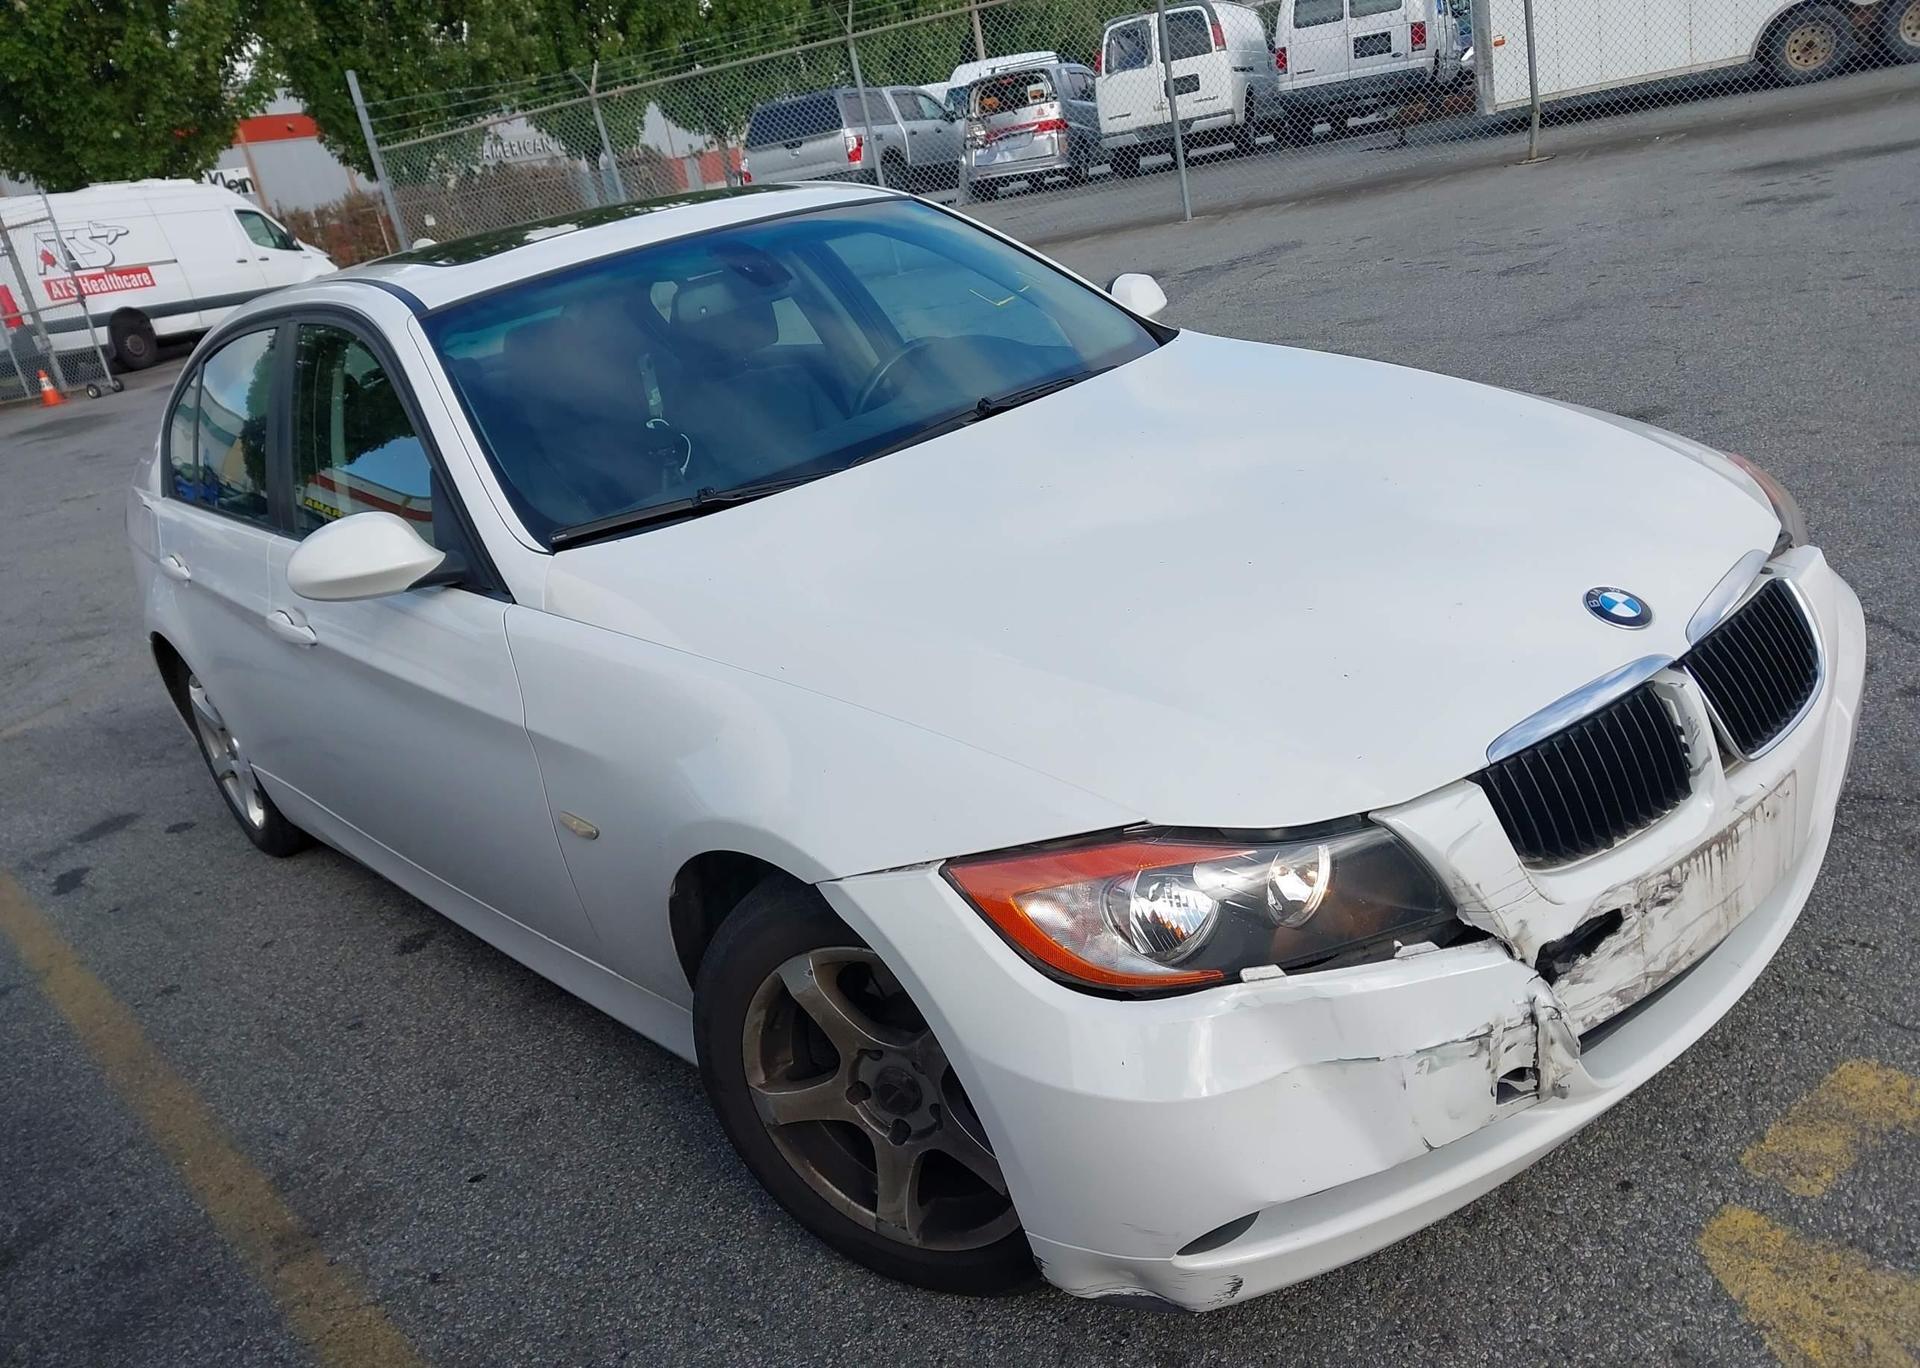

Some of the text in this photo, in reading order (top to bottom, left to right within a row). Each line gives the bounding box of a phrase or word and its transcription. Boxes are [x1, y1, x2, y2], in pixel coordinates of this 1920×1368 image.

[481, 137, 552, 160] AMERICAN
[50, 272, 152, 299] ATS Healthcare
